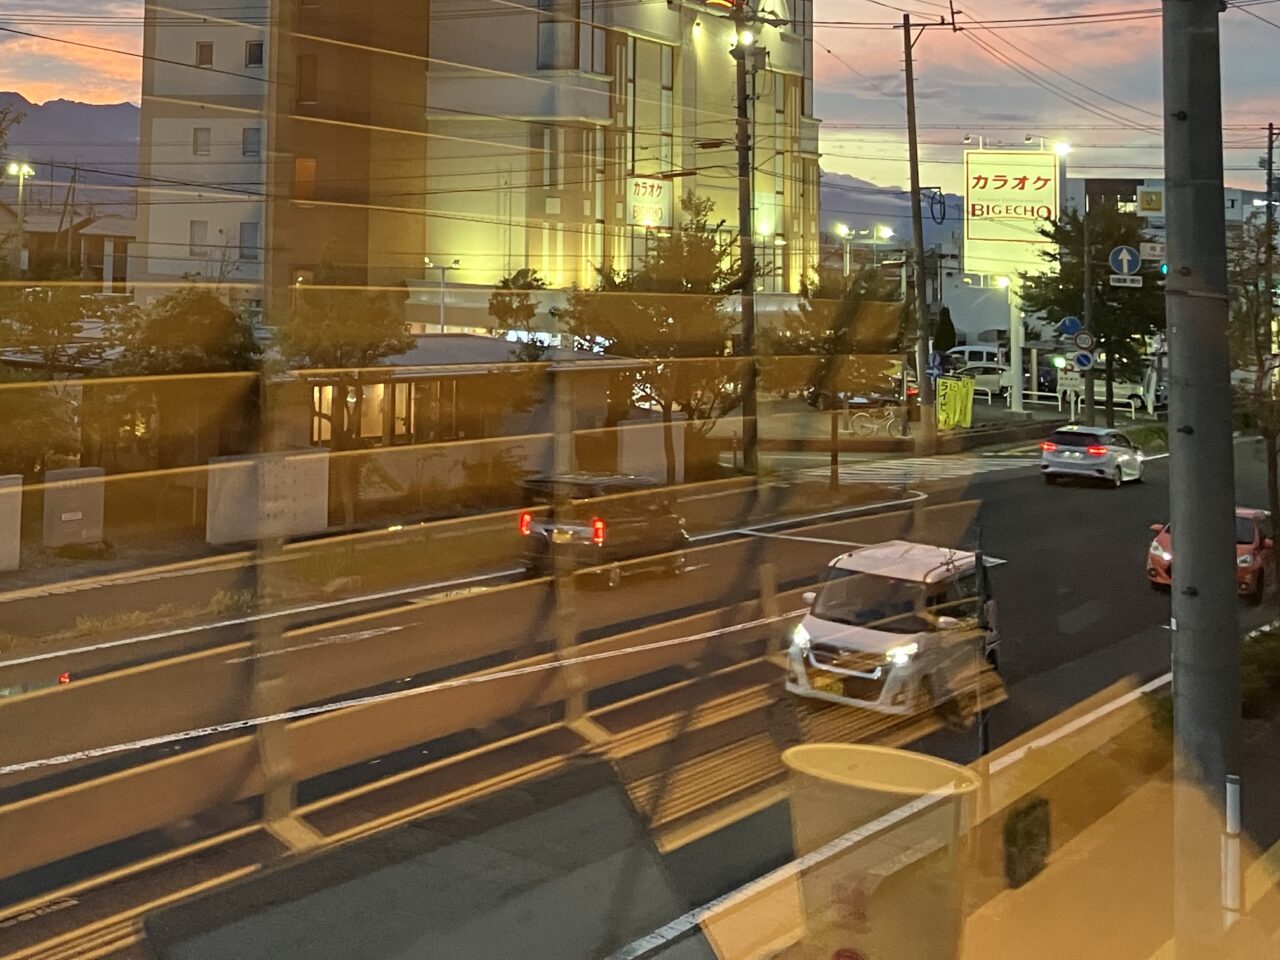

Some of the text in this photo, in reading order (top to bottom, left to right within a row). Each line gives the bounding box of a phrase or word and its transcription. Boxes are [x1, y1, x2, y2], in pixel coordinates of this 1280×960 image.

[633, 181, 663, 198] カラオケ
[971, 174, 1051, 191] カラオケ
[971, 203, 1052, 221] BIG ECHO
